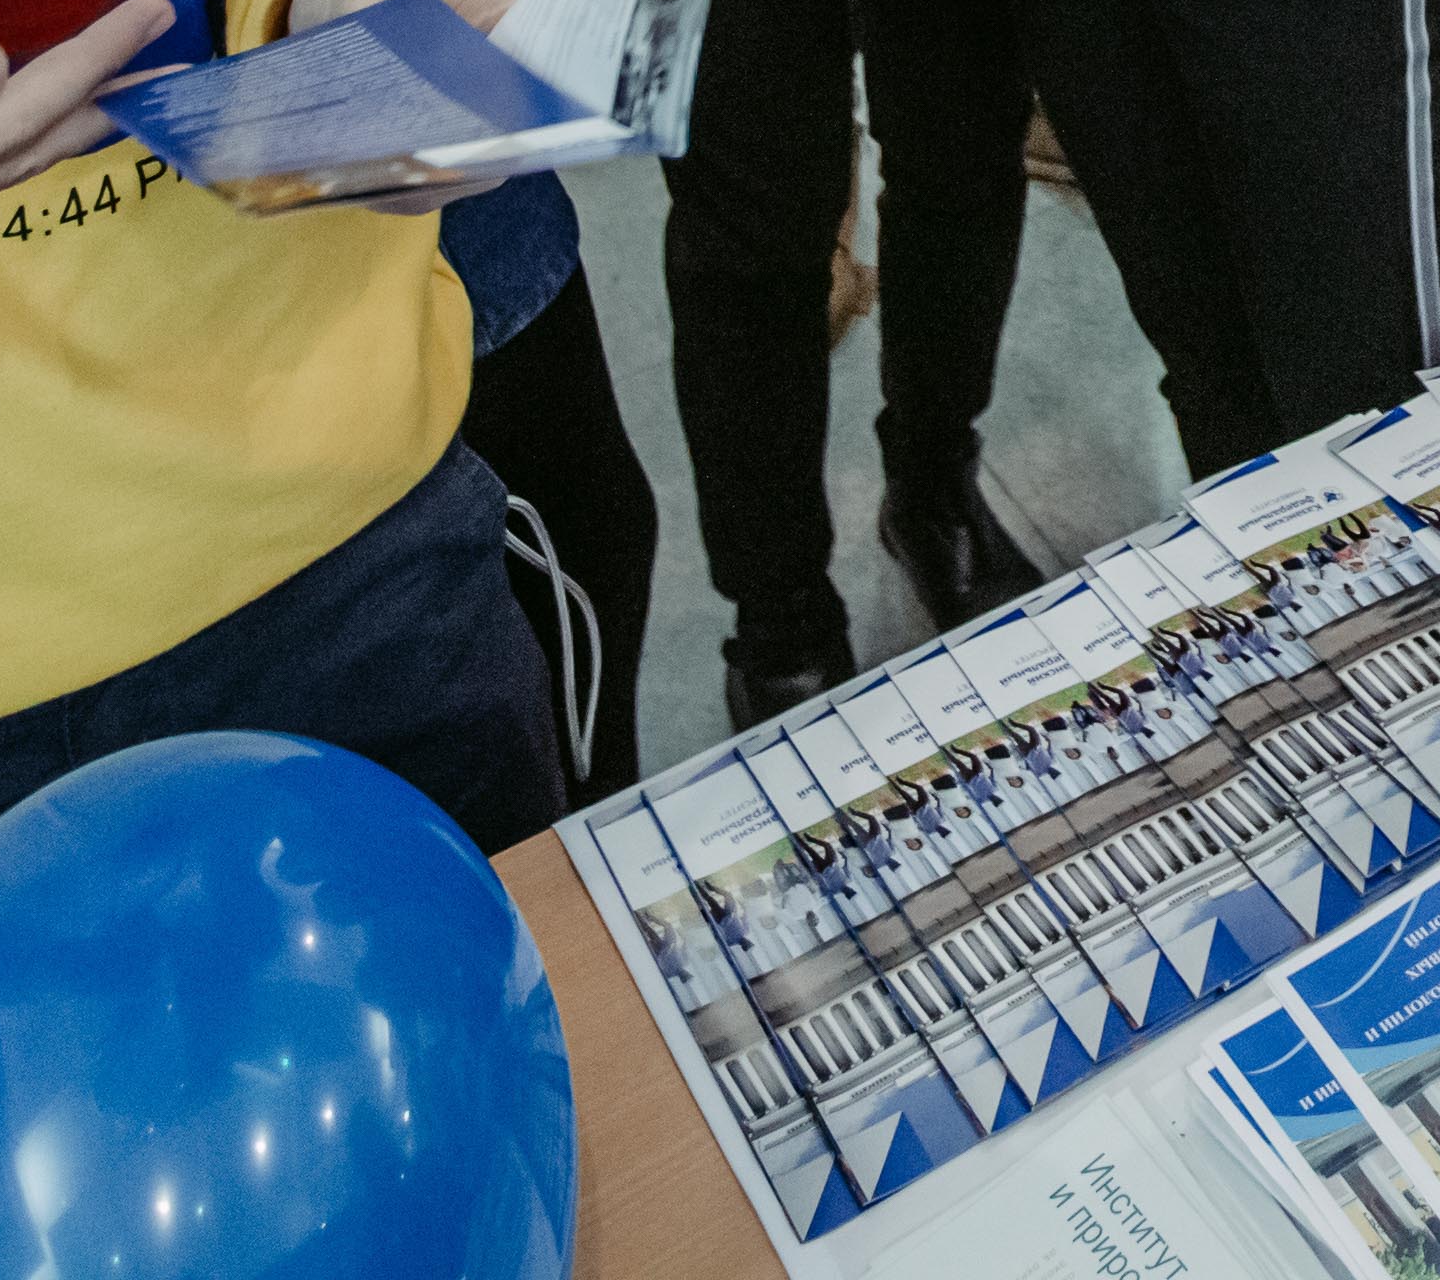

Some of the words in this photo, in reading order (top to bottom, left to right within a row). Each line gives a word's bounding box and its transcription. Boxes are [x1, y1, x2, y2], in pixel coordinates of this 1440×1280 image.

[2, 174, 121, 242] 4:44
[135, 154, 184, 200] P
[1237, 495, 1315, 532] федеральный
[1264, 503, 1324, 531] Казанский
[1364, 1027, 1381, 1042] И
[1048, 1182, 1076, 1209] и
[1079, 1151, 1189, 1280] Институт
